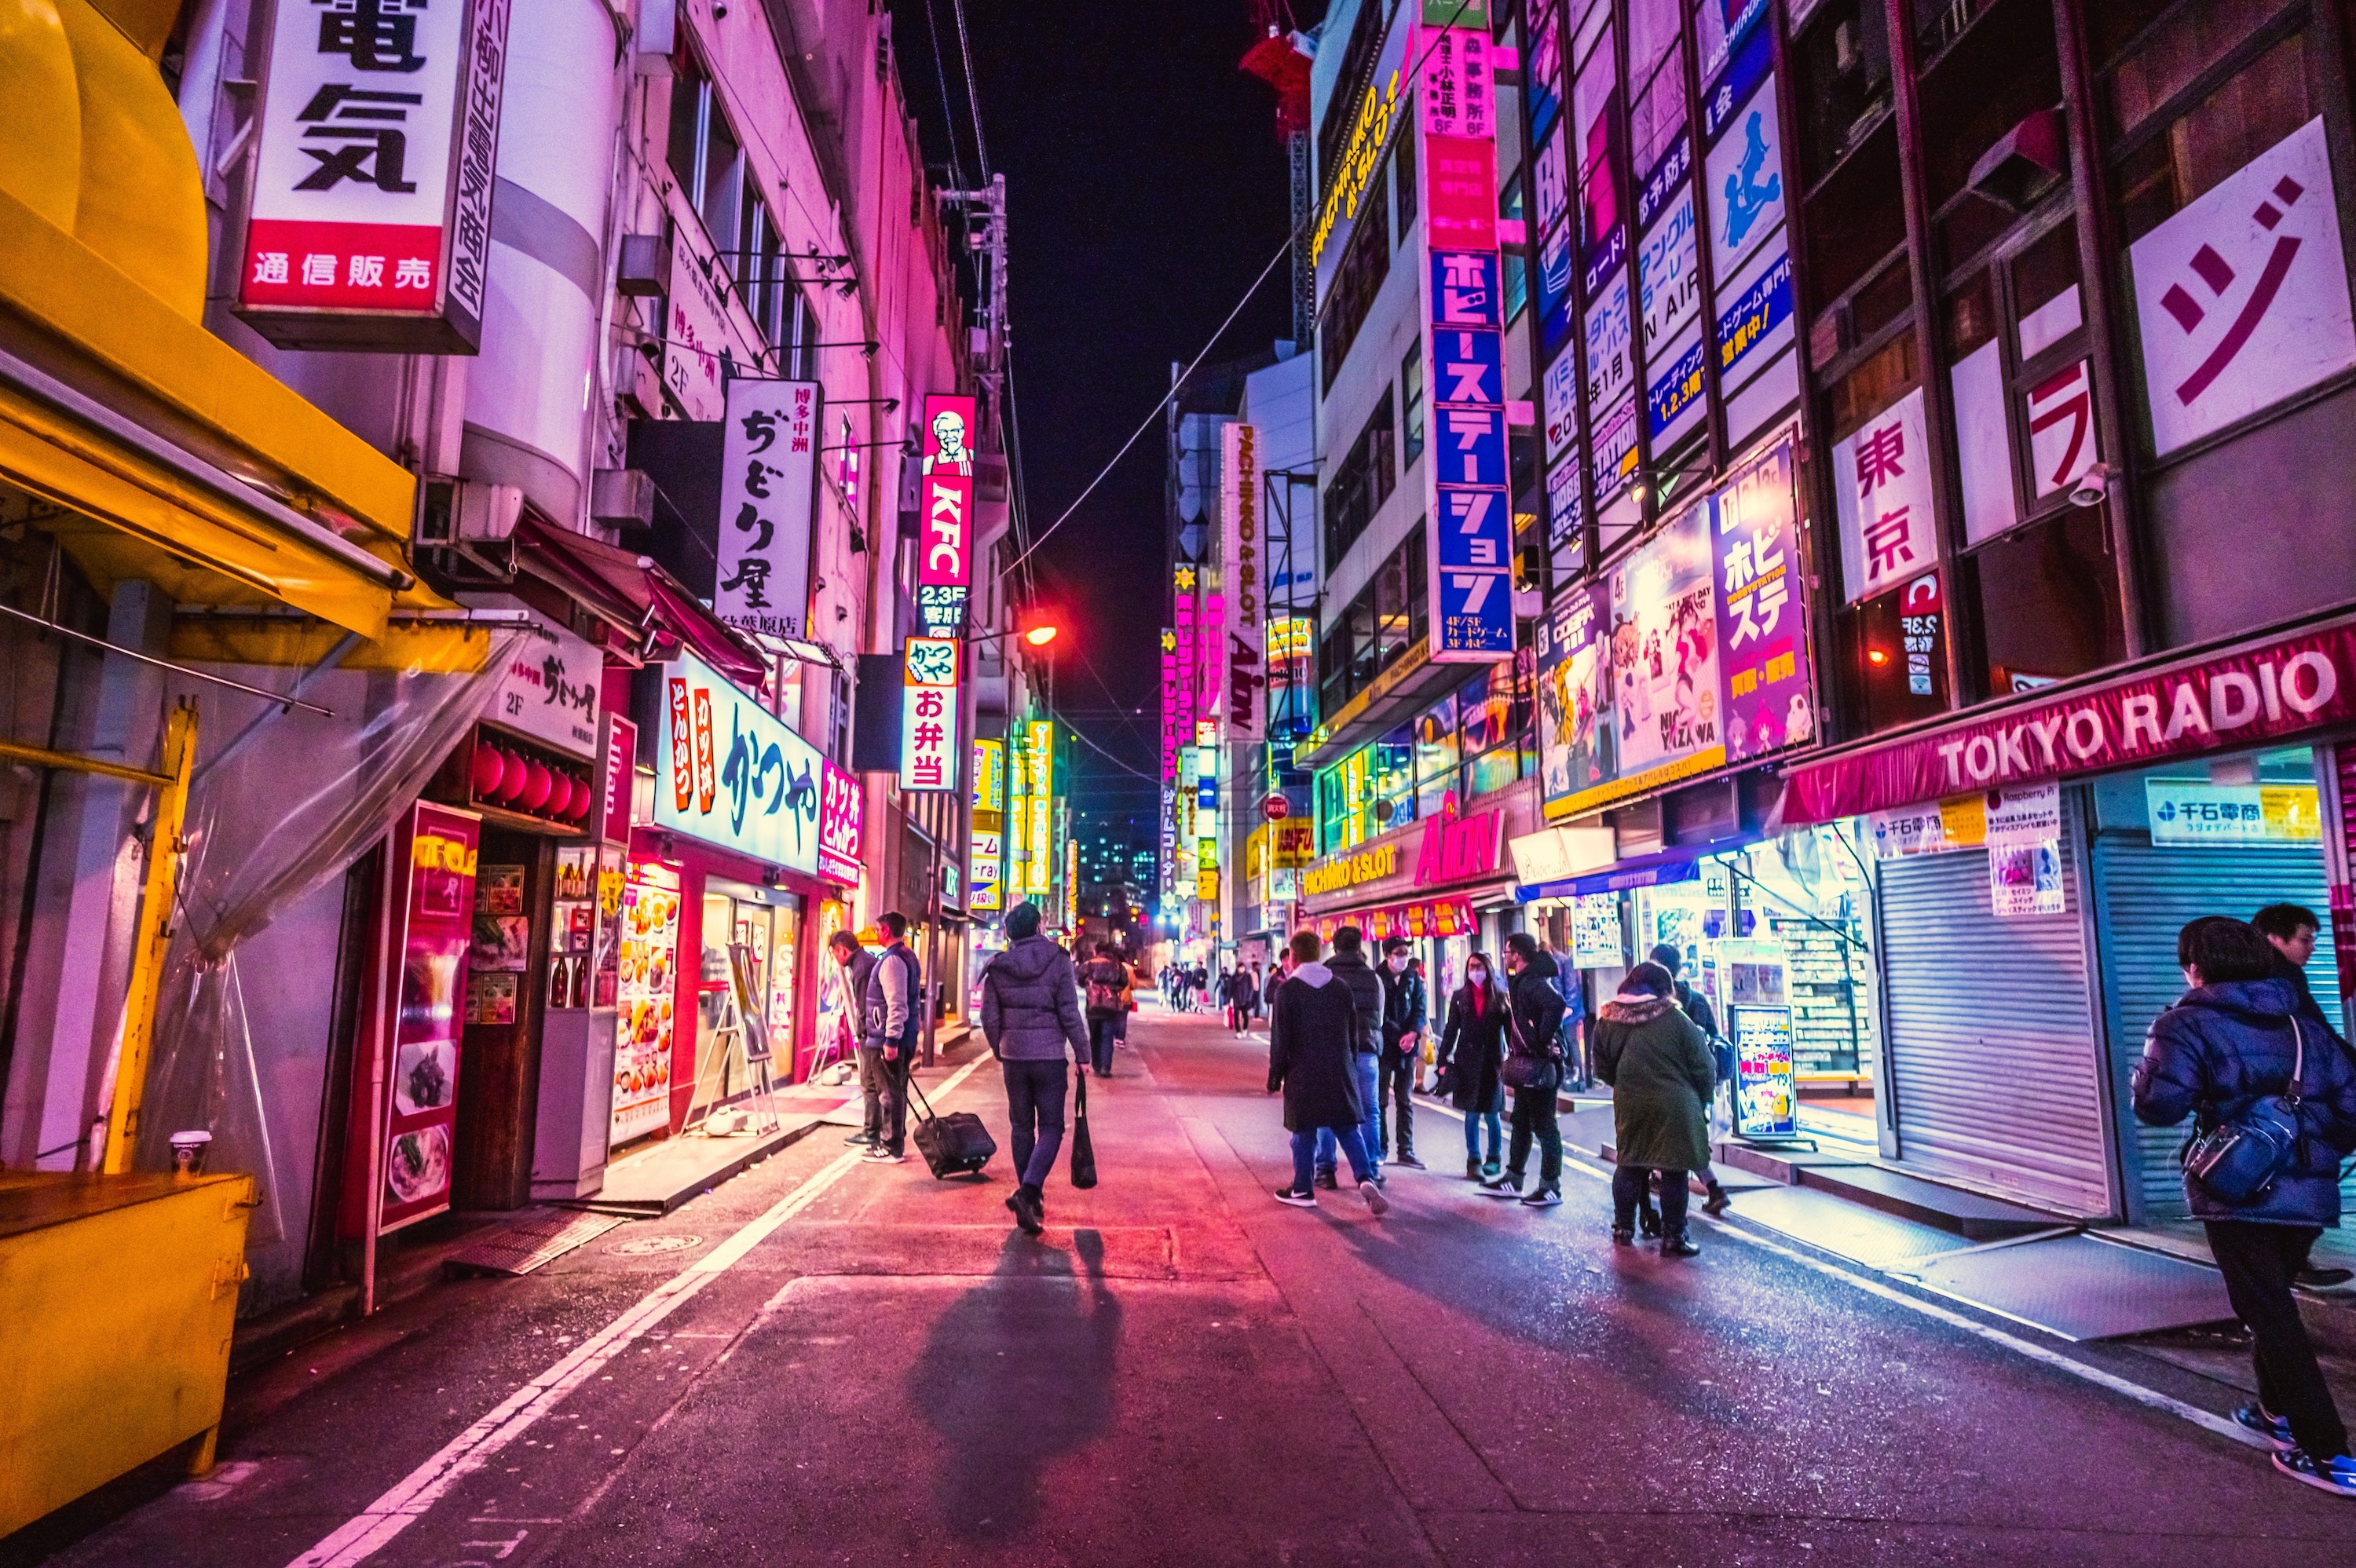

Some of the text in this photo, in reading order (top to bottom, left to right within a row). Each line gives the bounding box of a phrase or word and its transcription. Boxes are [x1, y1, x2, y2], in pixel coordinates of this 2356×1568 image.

[1434, 119, 1452, 133] 6F
[1466, 122, 1485, 134] 6F
[1312, 86, 1377, 267] PACHINKO
[252, 252, 431, 288] 通信販売
[671, 355, 689, 397] 2F
[792, 388, 810, 453] 博多中洲
[720, 408, 790, 609] ぢどり屋
[1238, 426, 1255, 543] PACHINKO
[1853, 419, 1916, 583] 東京
[927, 481, 962, 579] KFC
[920, 586, 967, 606] 2,3F
[1239, 564, 1256, 627] SLOT
[1446, 616, 1483, 627] 4F/5F
[506, 692, 524, 716] 2F
[1939, 651, 2339, 788] TOKYO RADIO
[605, 717, 623, 816] Lillian
[671, 683, 690, 795] とんかつ
[697, 696, 715, 798] カツ丼
[913, 690, 945, 785] お弁当
[721, 702, 817, 856] かつや
[825, 767, 860, 824] カツ丼
[2003, 788, 2045, 802] Raspberry
[823, 815, 858, 856] とんかつ
[1162, 789, 1176, 887] ゲームコーナー
[2180, 802, 2260, 821] 千石電商
[971, 837, 997, 855] ーム
